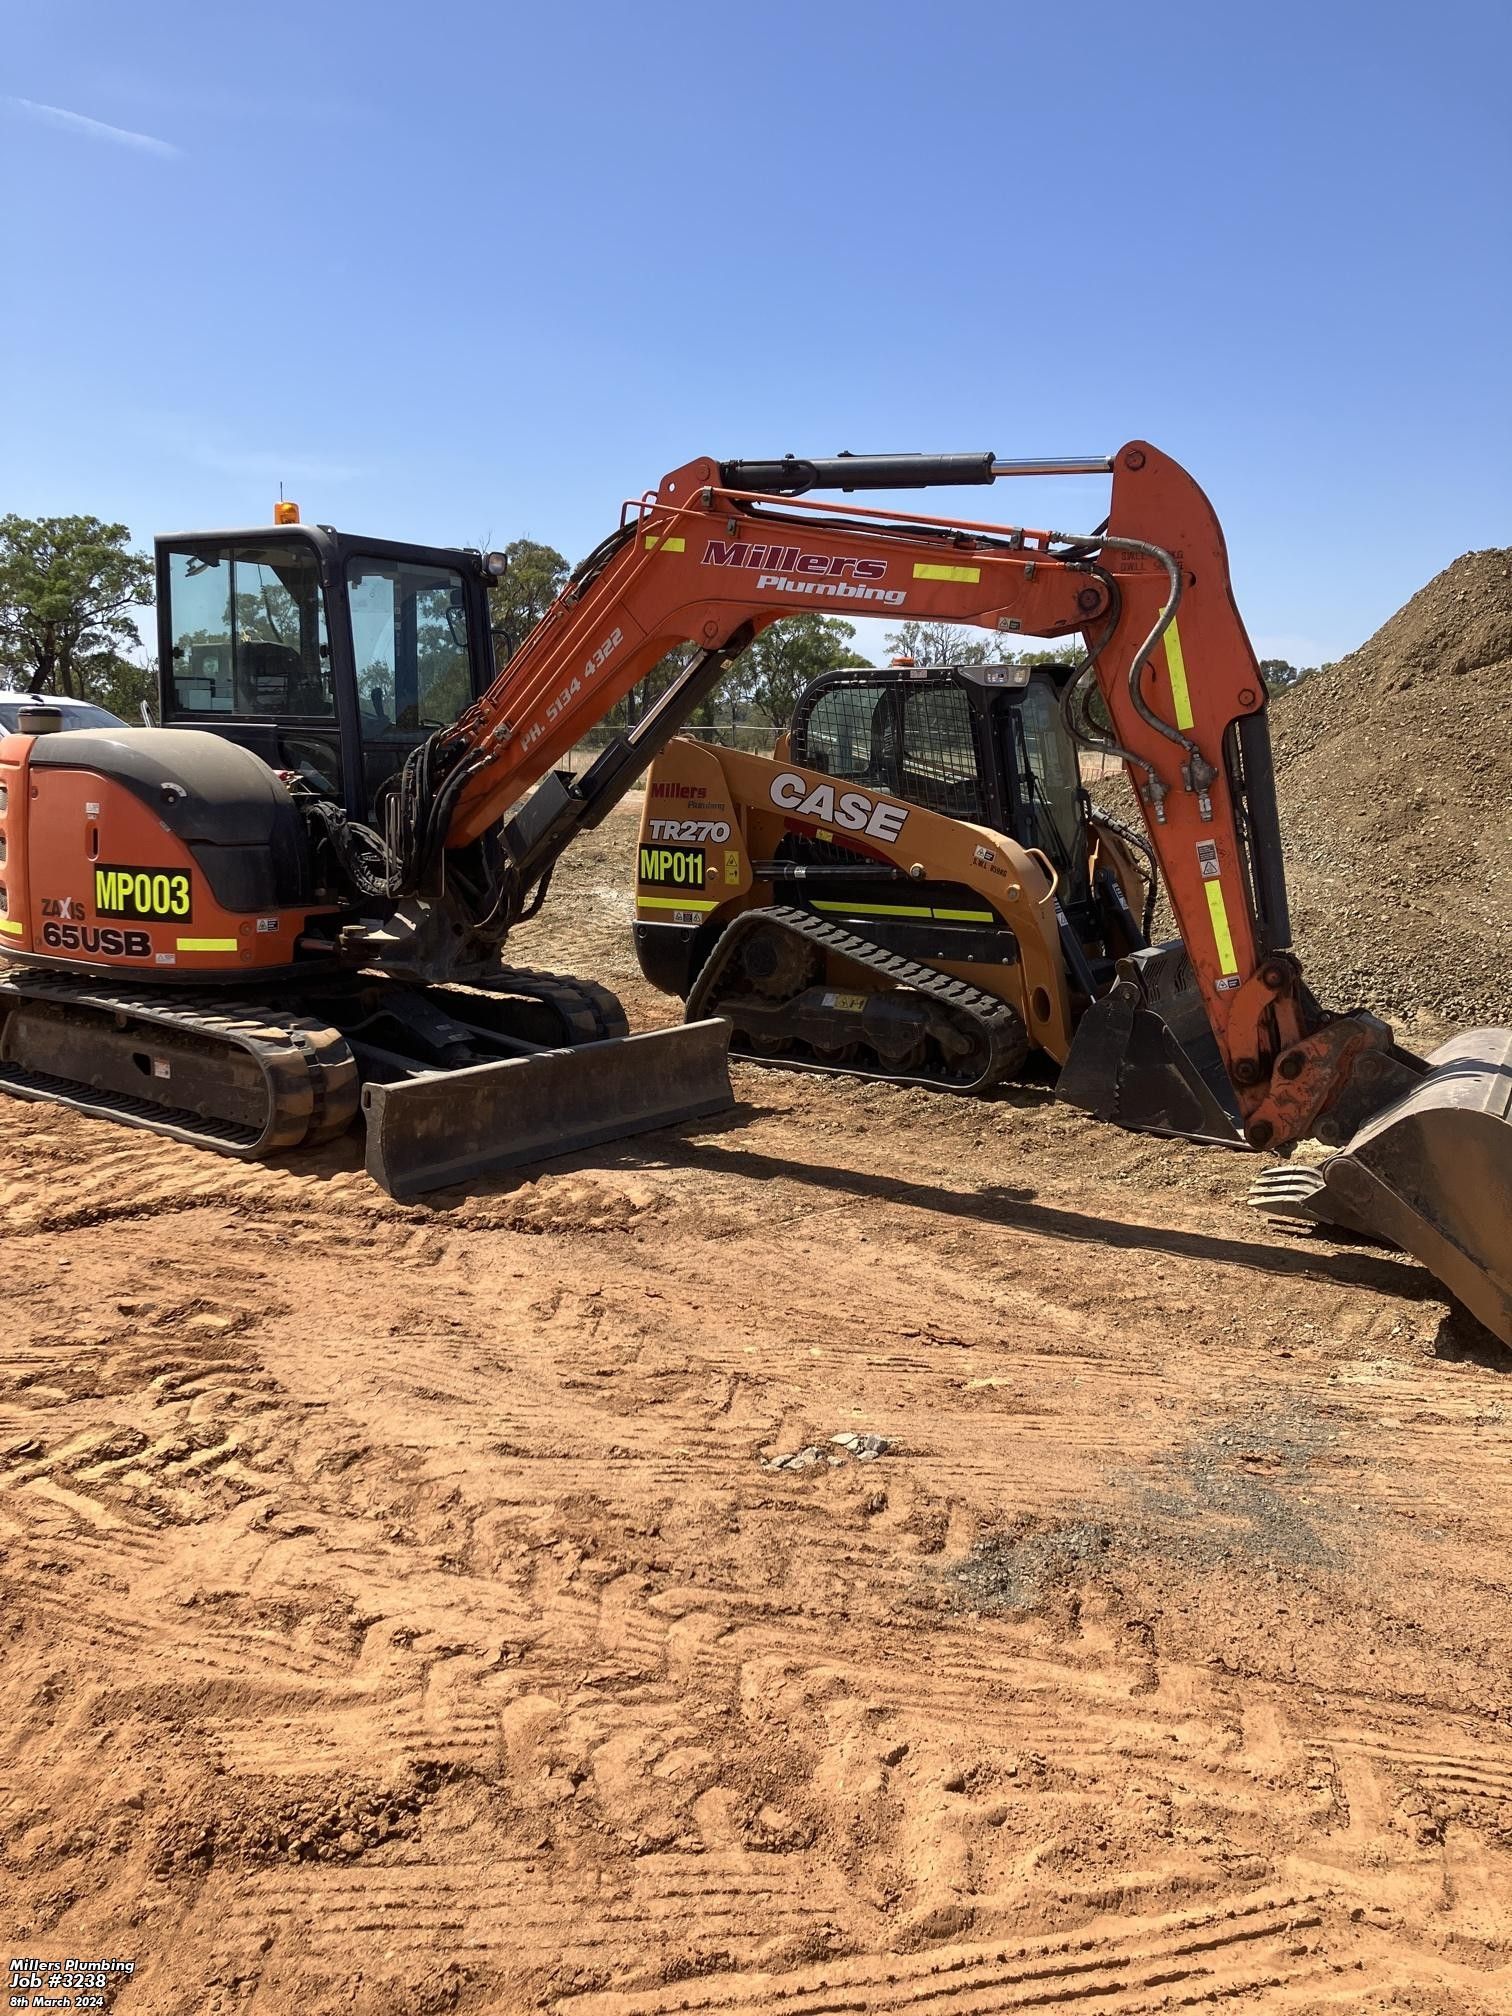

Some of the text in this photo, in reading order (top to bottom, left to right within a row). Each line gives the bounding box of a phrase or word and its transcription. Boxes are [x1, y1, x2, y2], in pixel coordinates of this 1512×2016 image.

[700, 540, 888, 580] Millers
[756, 575, 907, 605] Plumbing
[520, 627, 624, 752] PH. 5134 4322
[651, 782, 708, 799] Millers
[769, 772, 911, 844] CASE
[649, 819, 731, 843] TR270
[640, 849, 703, 884] MP011
[41, 896, 86, 921] ZAXIS
[95, 870, 190, 915] MP003
[43, 920, 153, 959] 65USB
